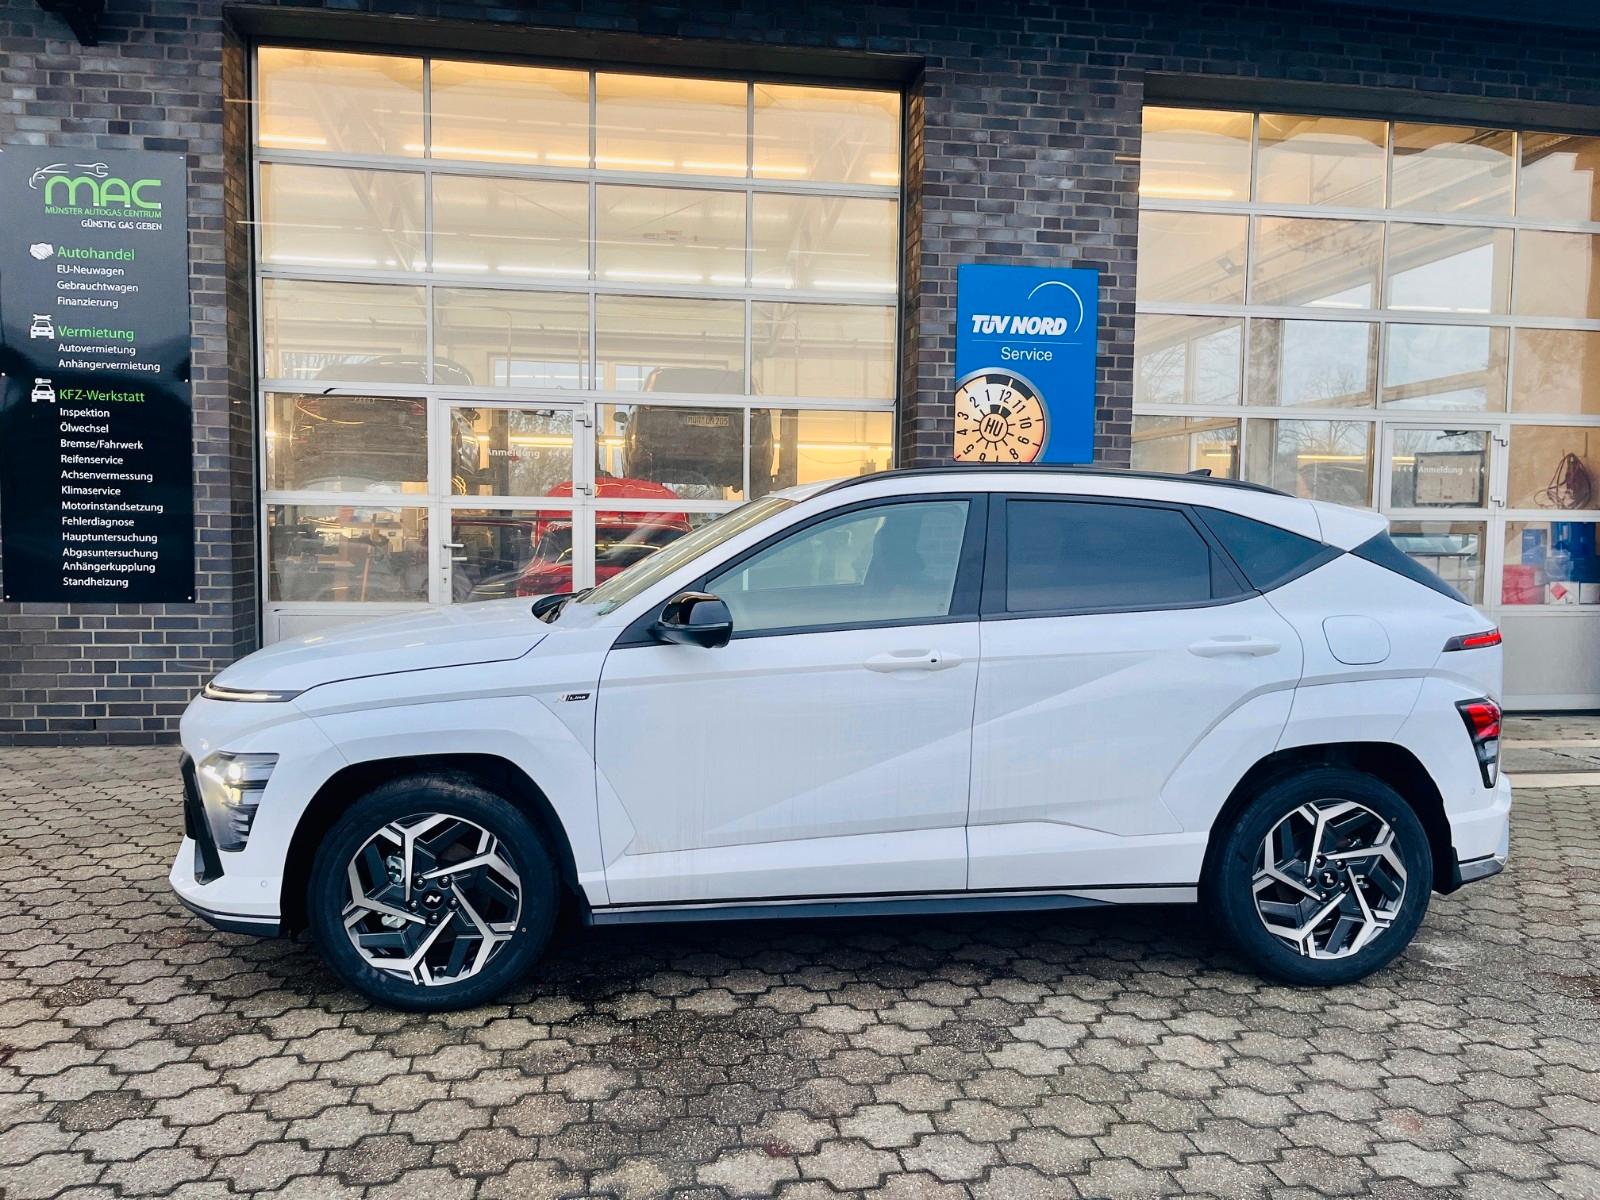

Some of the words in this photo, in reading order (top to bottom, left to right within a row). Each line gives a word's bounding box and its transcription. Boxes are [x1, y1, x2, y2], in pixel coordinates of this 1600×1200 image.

[45, 175, 161, 209] MAC
[45, 205, 82, 216] MÜNSTER
[84, 207, 122, 217] AUTOGAS
[123, 208, 162, 218] CENTRUM
[81, 218, 116, 229] GÜNSTIG
[118, 220, 134, 230] GAS
[136, 221, 162, 231] GEBEN
[57, 246, 135, 261] Autohandel
[56, 265, 125, 278] EU-Neuwagen
[56, 280, 139, 294] Gebrauchtwagen
[57, 296, 119, 309] Finanzierung
[972, 314, 1011, 334] TÜV
[1011, 316, 1068, 336] NORD
[58, 325, 135, 342] Vermietung
[58, 343, 136, 357] Autovermietung
[1000, 346, 1053, 361] Service
[58, 358, 161, 373] Anhängervermietung
[59, 388, 145, 403] KFZ-Werkstatt
[985, 388, 990, 401] 1
[1000, 388, 1012, 404] 12
[969, 396, 980, 408] 2
[59, 407, 111, 419] Inspektion
[59, 421, 109, 434] Ölwechsel
[984, 417, 1004, 437] HU
[60, 438, 144, 450] Bremse/Fahrwerk
[60, 454, 124, 465] Reifenservice
[488, 448, 540, 459] Anmeldung
[60, 470, 153, 482] Achsenvermessung
[1419, 465, 1464, 476] Anmeldung
[61, 485, 122, 496] Klimaservice
[61, 500, 164, 513] Motorinstandsetzung
[61, 516, 135, 528] Fehlerdiagnose
[62, 532, 158, 544] Hauptuntersuchung
[62, 547, 158, 560] Abgasuntersuchung
[62, 562, 156, 574] Anhängerkupplung
[63, 577, 129, 588] Standheizung
